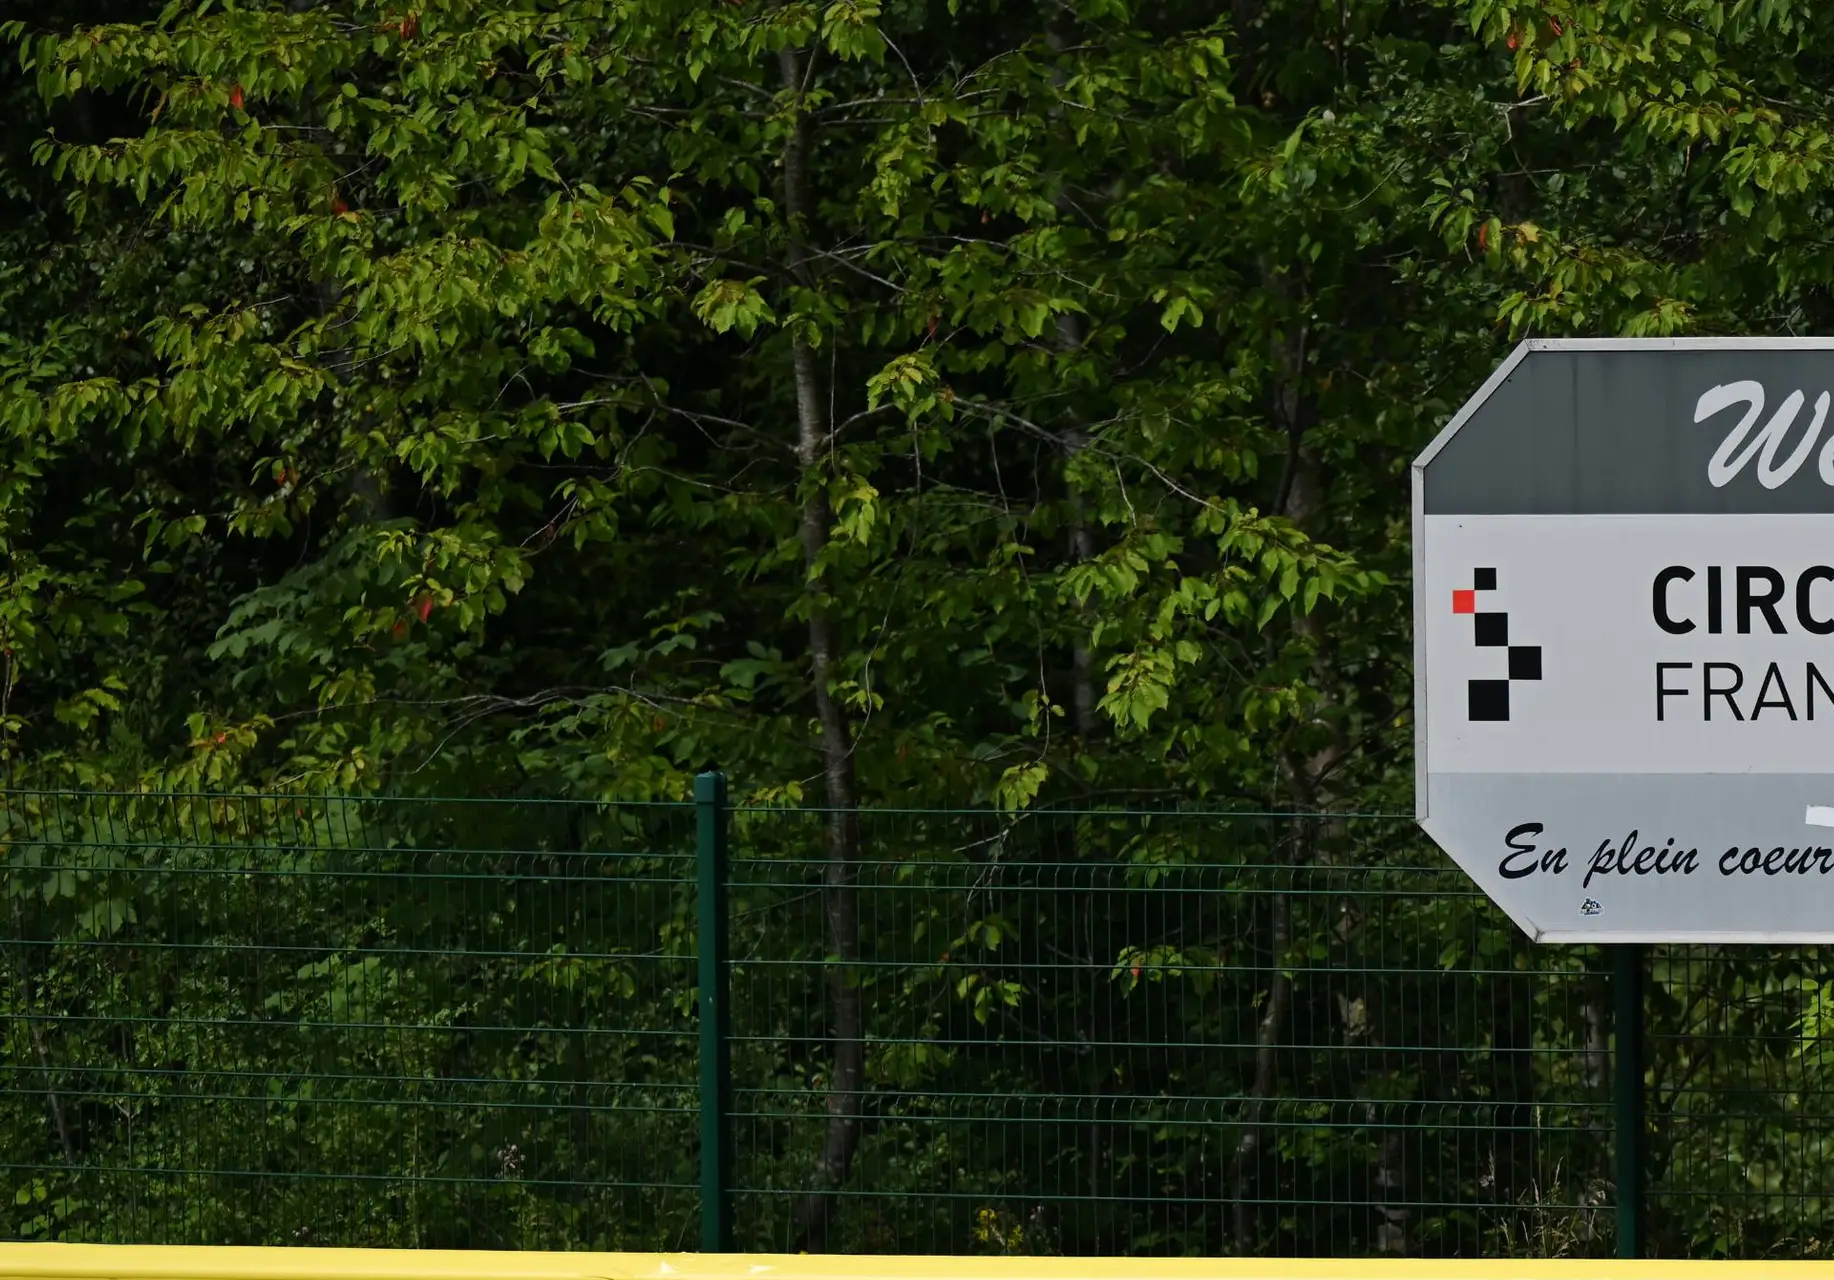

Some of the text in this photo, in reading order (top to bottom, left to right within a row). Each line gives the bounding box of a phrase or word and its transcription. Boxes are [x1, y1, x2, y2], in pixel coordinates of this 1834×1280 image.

[1498, 822, 1569, 880] En
[1582, 829, 1700, 889] plein
[1718, 846, 1834, 877] coeur
